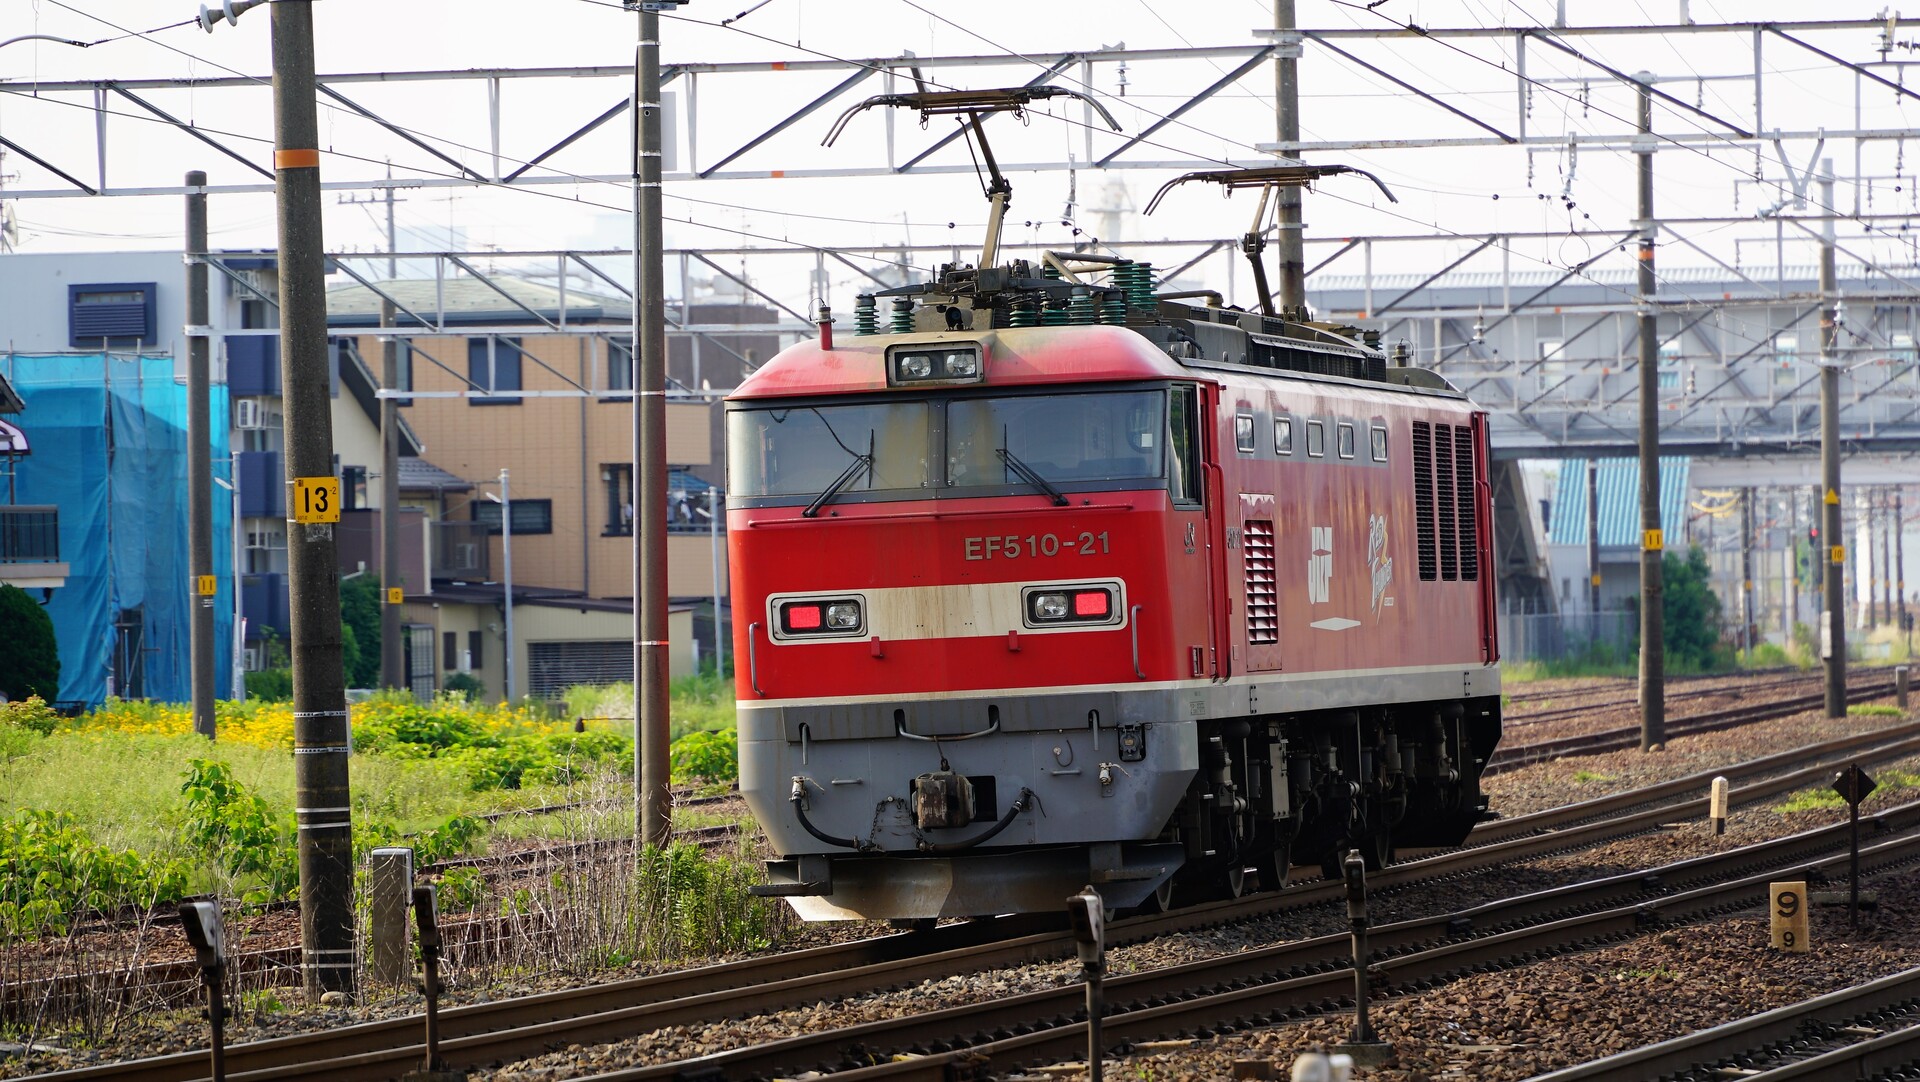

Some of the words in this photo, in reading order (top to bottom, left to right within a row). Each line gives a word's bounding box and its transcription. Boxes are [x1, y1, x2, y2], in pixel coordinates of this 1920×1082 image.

[304, 486, 329, 513] 13
[964, 531, 1111, 561] EF510-21
[1777, 891, 1800, 918] 9
[1783, 931, 1795, 948] 9
